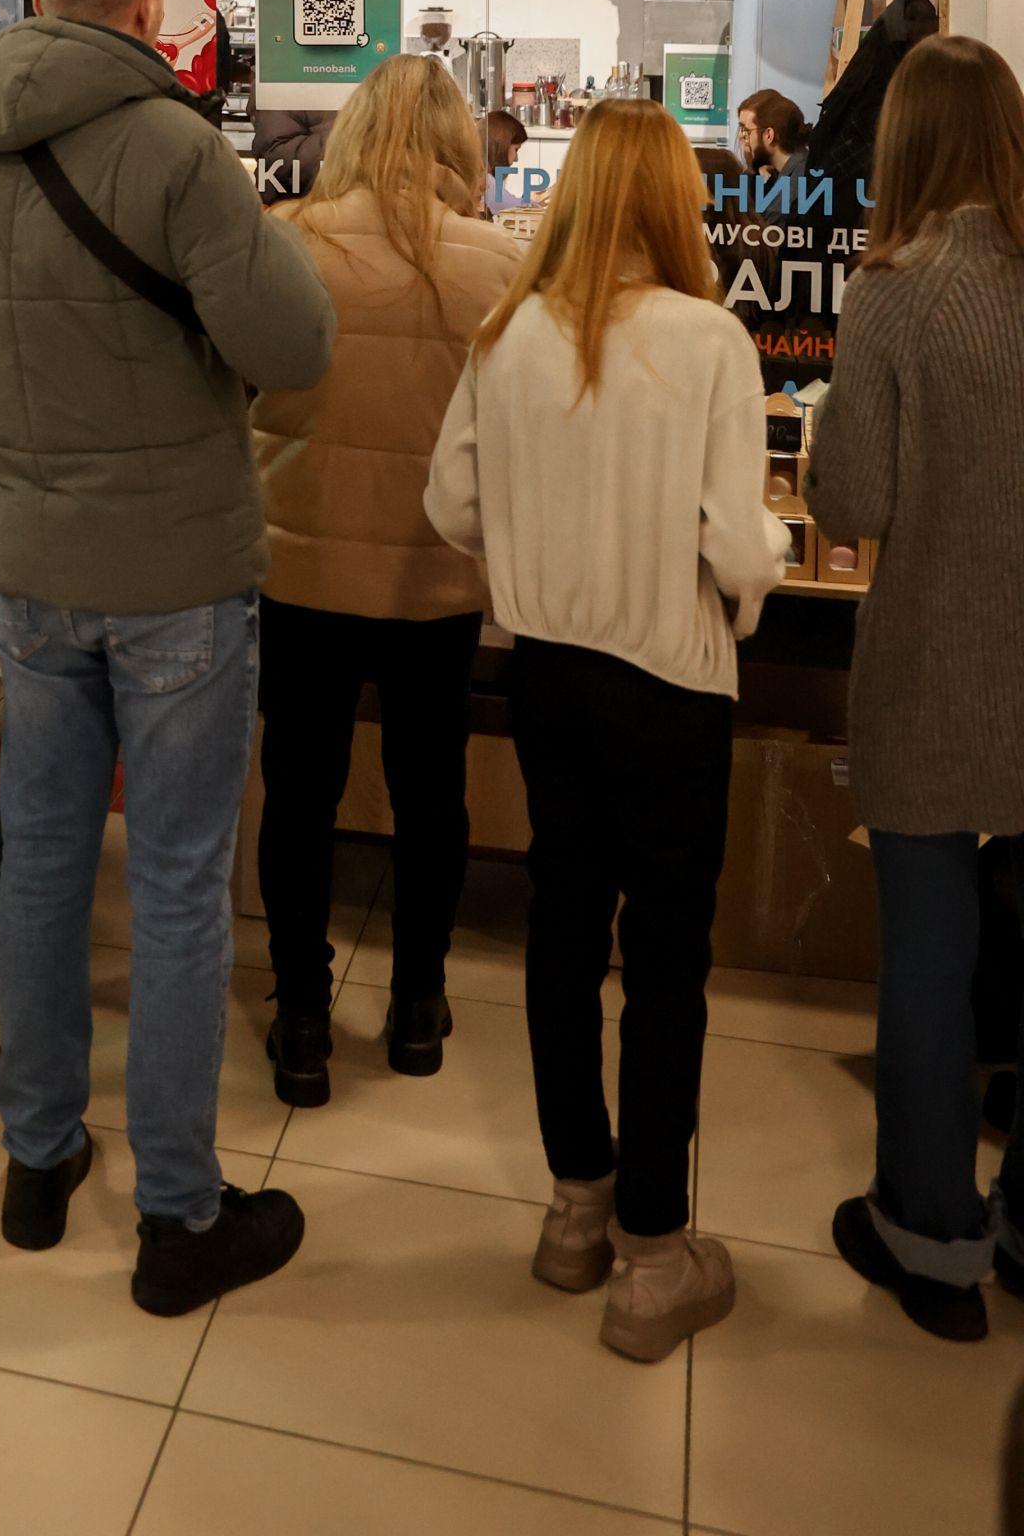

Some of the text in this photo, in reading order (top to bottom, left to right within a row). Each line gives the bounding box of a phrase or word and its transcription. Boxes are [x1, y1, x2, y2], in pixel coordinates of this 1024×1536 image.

[302, 64, 357, 73] monobank
[494, 166, 561, 204] ГР
[700, 168, 834, 216] НИЙ
[702, 222, 870, 255] МУСОВІ ДЕ
[754, 330, 834, 359] ЧАЙН
